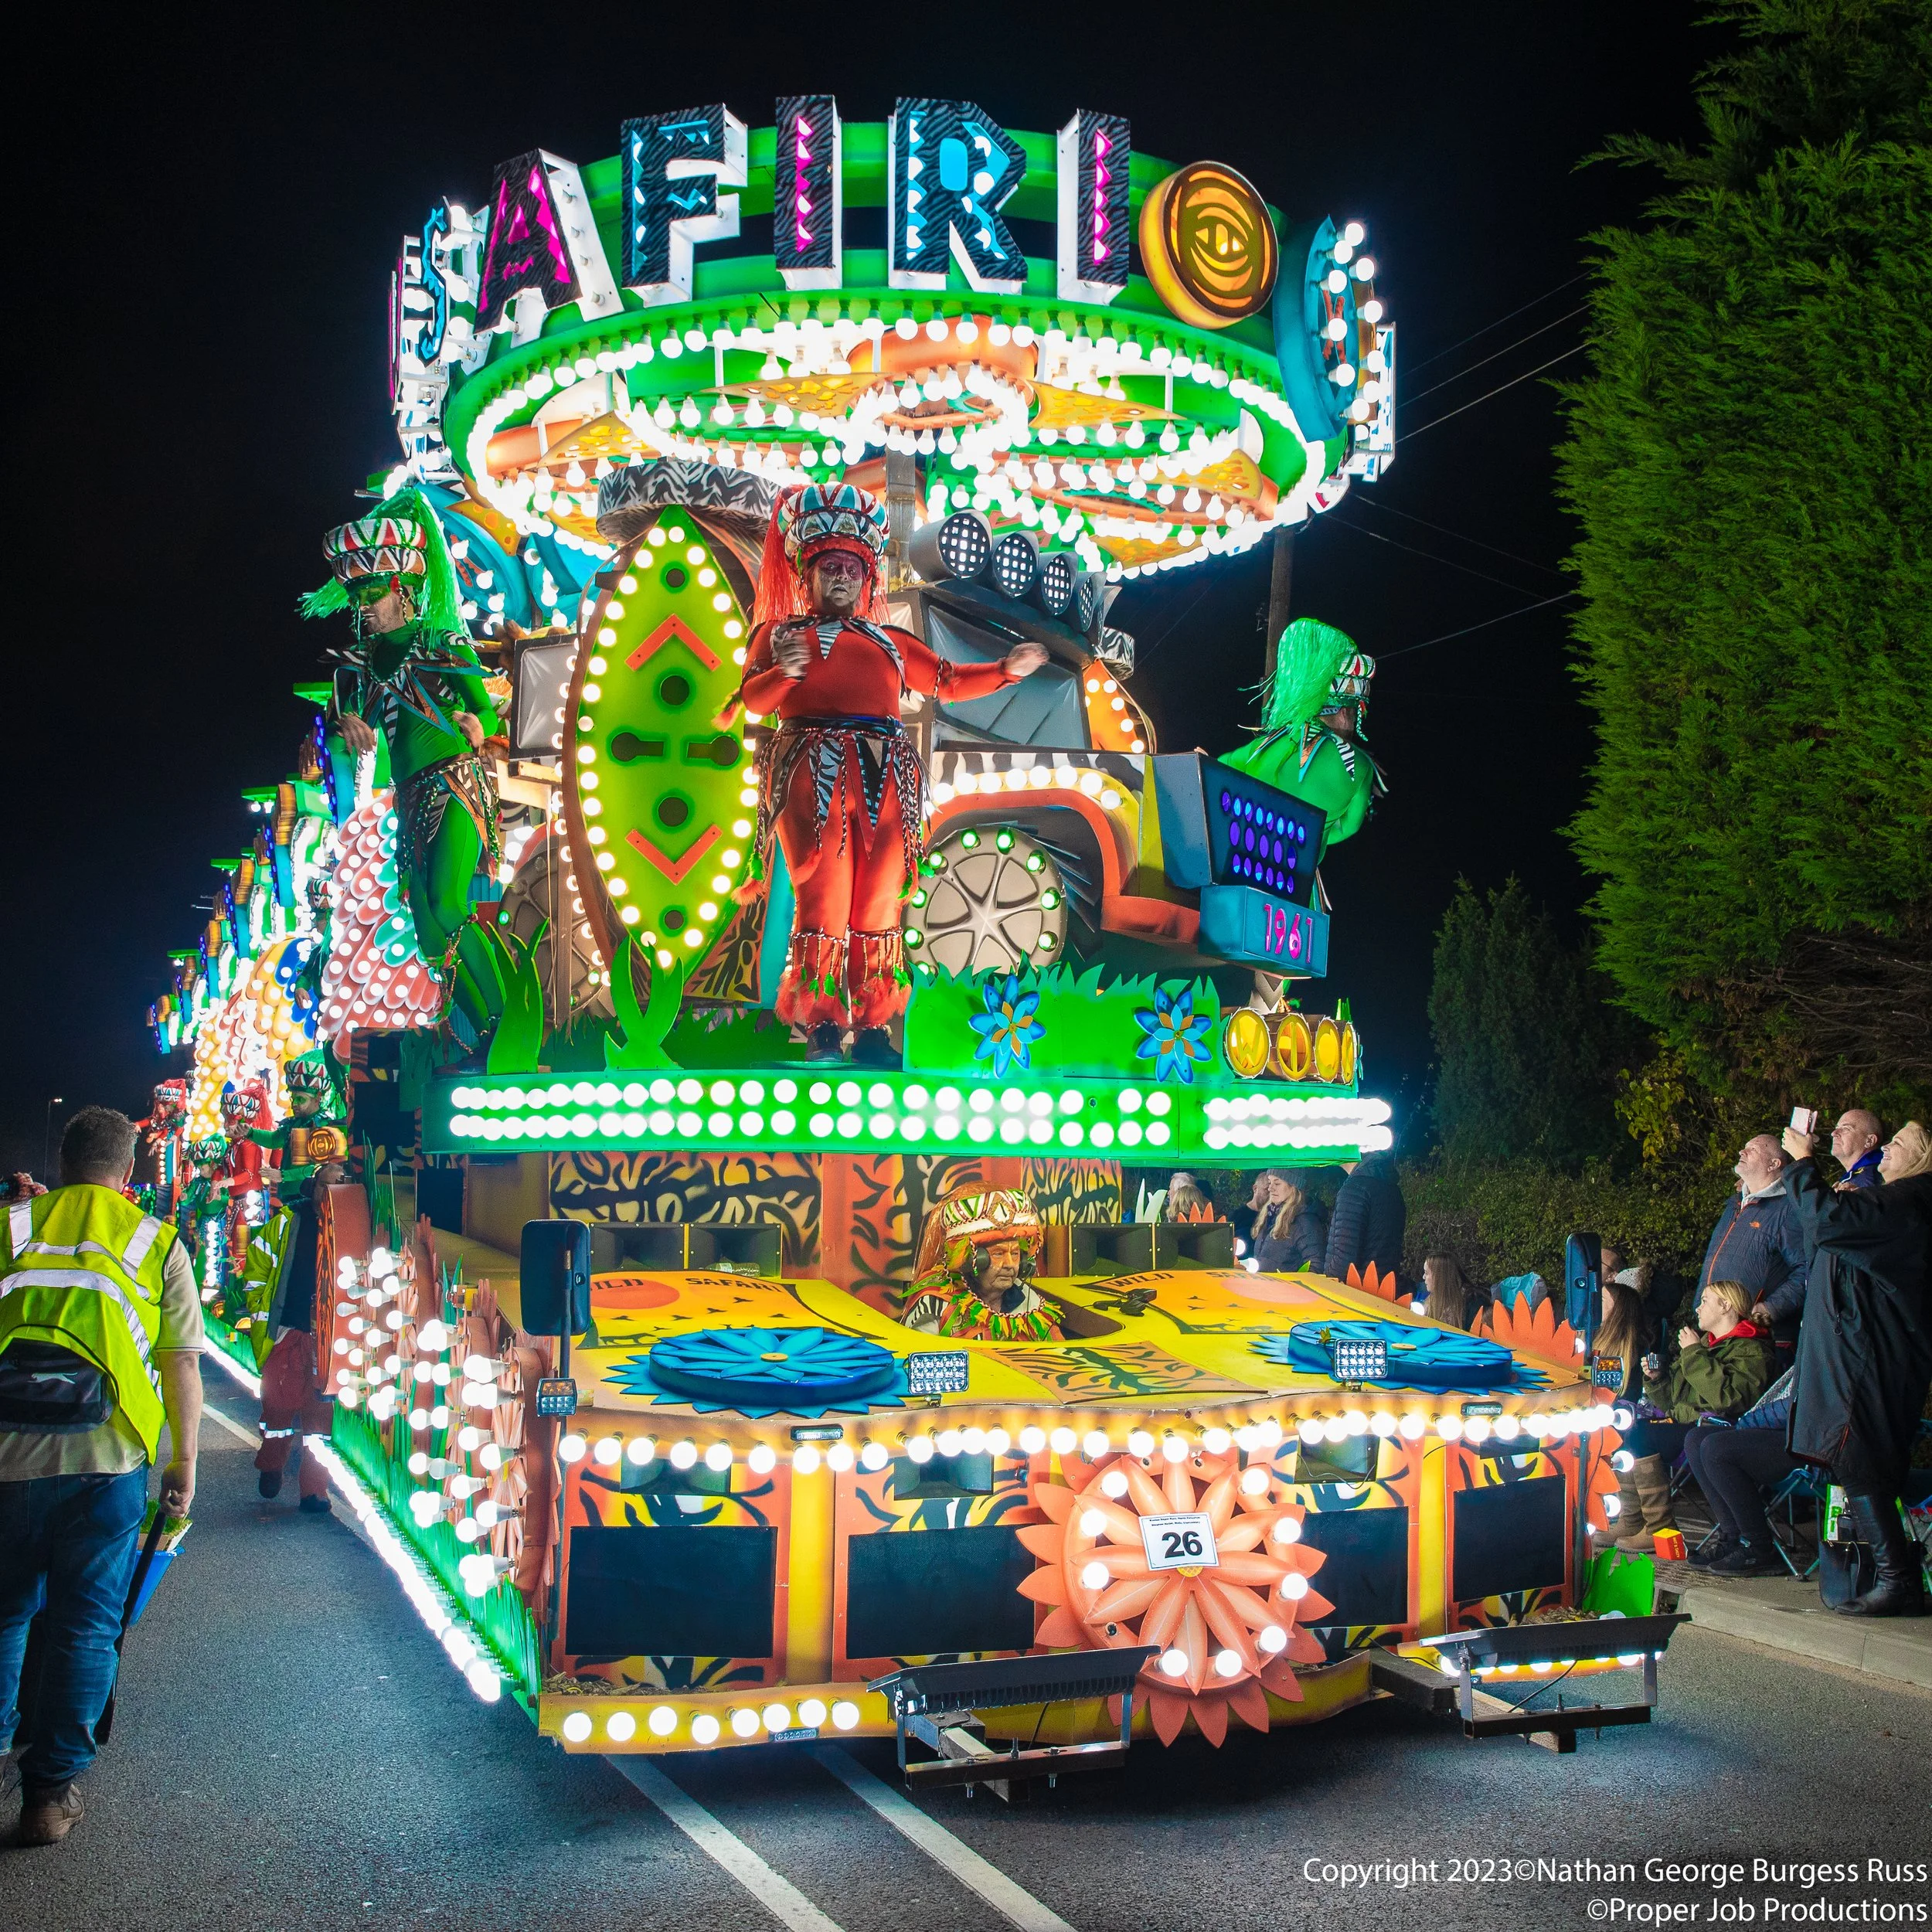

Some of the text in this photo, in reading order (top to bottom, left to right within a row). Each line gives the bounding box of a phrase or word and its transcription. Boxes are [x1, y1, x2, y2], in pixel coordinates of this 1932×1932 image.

[1264, 903, 1312, 964] 1961
[590, 1277, 782, 1293] ILD SAFARI
[1106, 1273, 1175, 1287] WILD
[1162, 1531, 1202, 1559] 26
